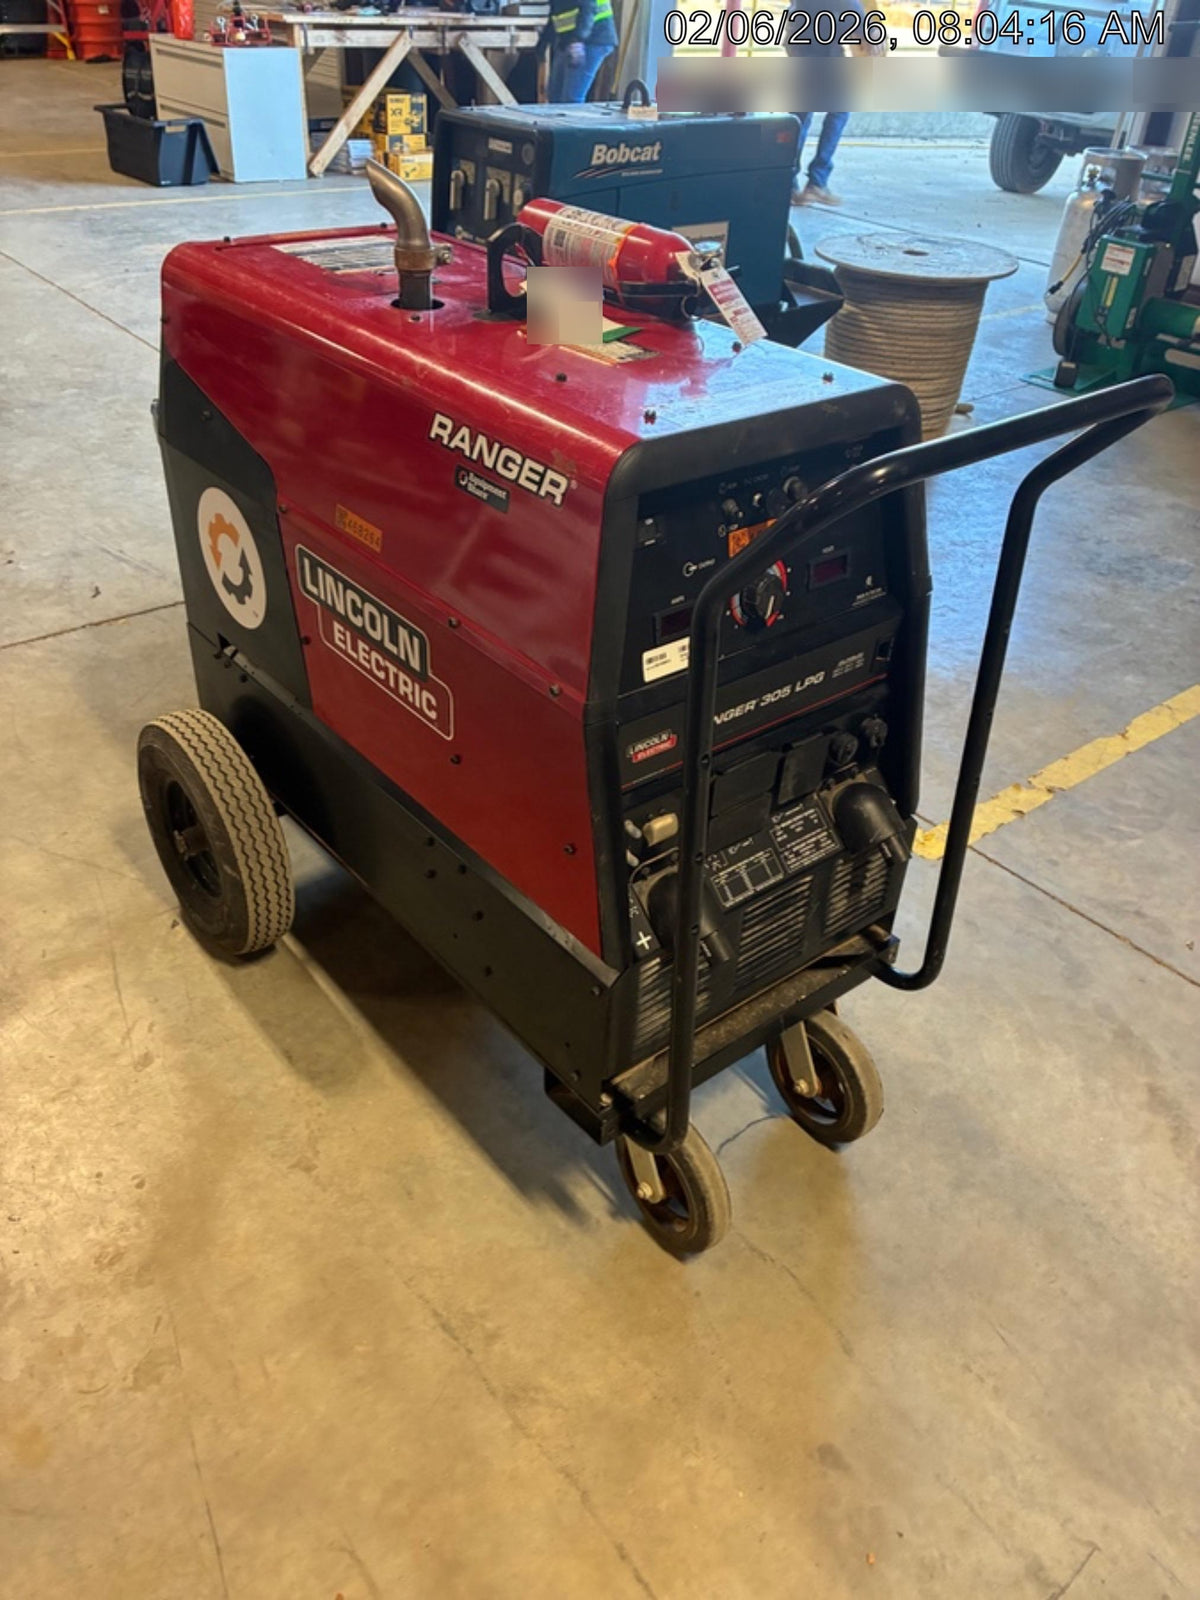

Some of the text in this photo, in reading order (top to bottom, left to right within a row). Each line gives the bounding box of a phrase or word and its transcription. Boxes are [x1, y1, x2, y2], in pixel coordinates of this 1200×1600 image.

[591, 141, 662, 166] Bobcat
[430, 413, 568, 505] RANGER
[303, 557, 421, 672] LINCOLN
[333, 620, 437, 720] ELECTRIC
[714, 671, 825, 725] NGER 305 LPG
